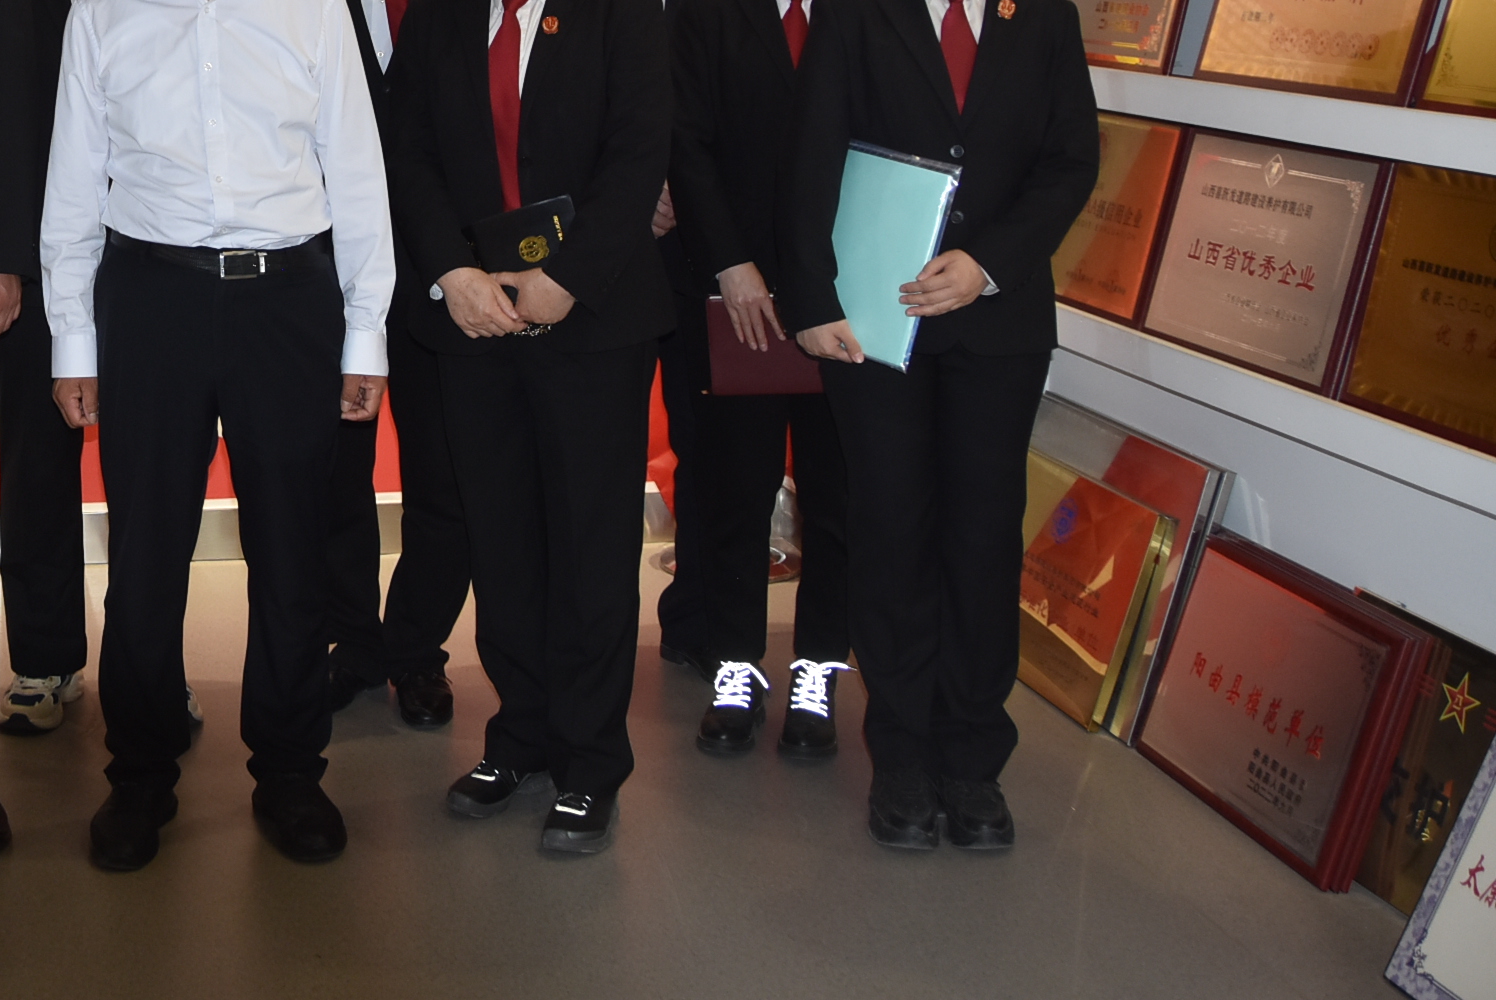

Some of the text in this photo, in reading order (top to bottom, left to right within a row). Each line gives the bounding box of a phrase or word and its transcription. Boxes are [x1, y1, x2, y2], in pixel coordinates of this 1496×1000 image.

[1187, 237, 1316, 292] 山西省优秀企业
[1189, 650, 1325, 761] 阳曲县模范单位
